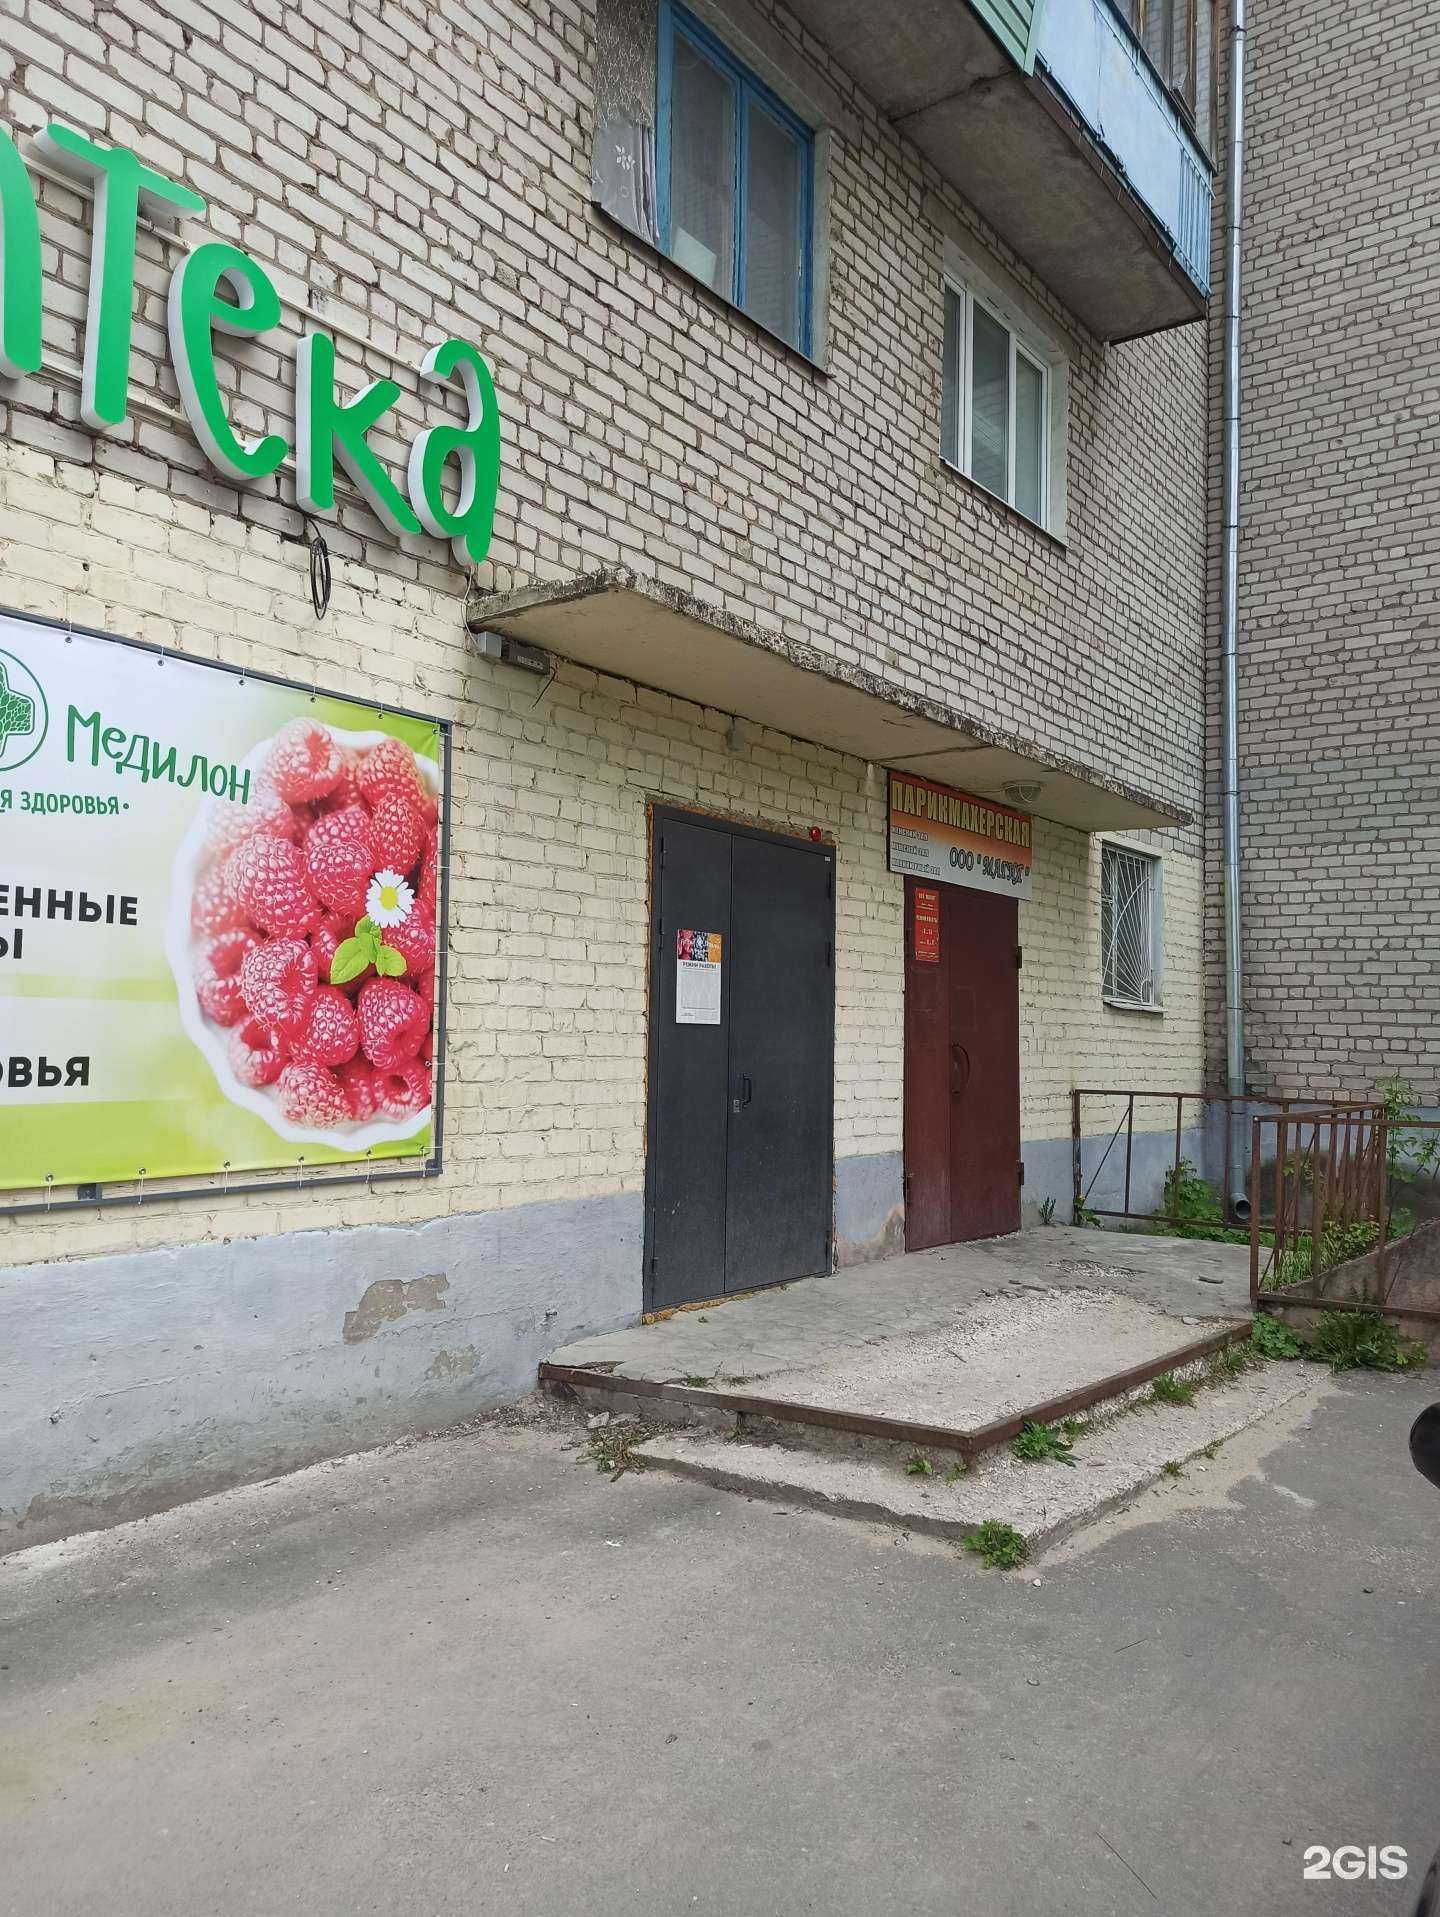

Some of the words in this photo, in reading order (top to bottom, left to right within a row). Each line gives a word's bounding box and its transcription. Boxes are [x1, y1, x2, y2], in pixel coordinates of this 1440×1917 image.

[67, 704, 250, 804] Медилон
[892, 780, 1031, 848] ПАРИКМАХЕРСКАЯ
[950, 847, 975, 872] ООО
[0, 1056, 90, 1087] ВЬЯ
